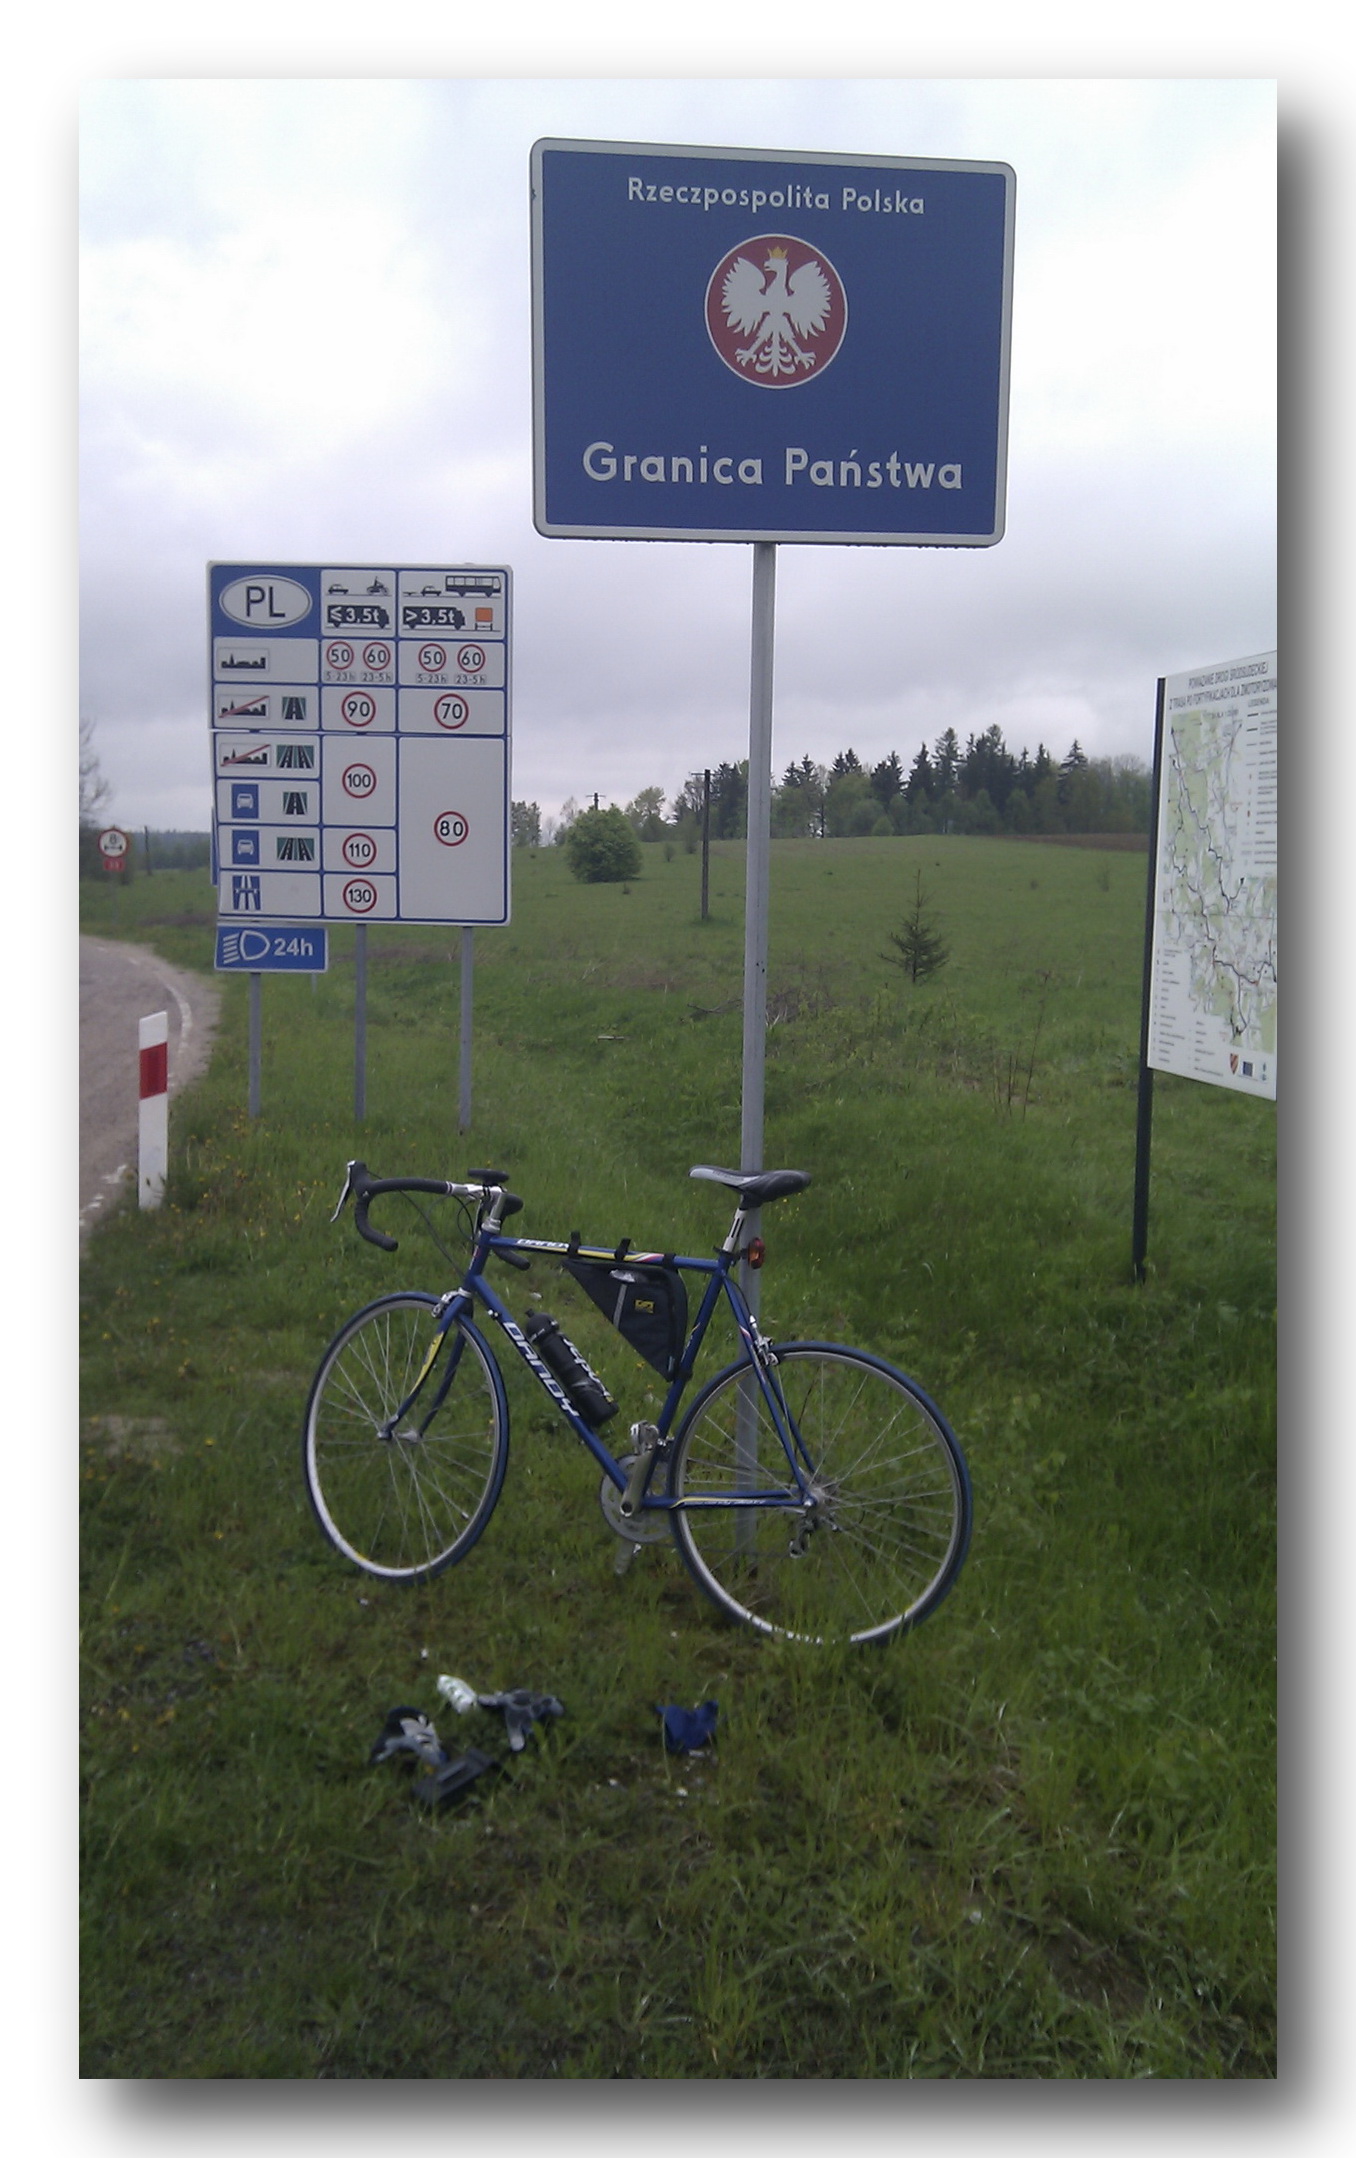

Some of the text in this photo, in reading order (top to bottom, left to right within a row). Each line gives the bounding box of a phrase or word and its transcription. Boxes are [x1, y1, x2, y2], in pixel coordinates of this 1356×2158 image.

[627, 177, 925, 215] Rzeczpospolita Polska
[582, 441, 963, 490] Granica Państwa
[246, 586, 286, 618] PL
[331, 649, 350, 663] 50
[367, 649, 387, 664] 60
[423, 651, 443, 666] 50
[461, 651, 482, 666] 60
[347, 700, 371, 718] 90
[442, 703, 462, 720] 70
[347, 773, 371, 788] 100
[440, 820, 464, 838] 80
[348, 843, 371, 858] 110
[348, 889, 372, 903] 130
[273, 938, 314, 957] 24h
[503, 1321, 580, 1417] DANDY
